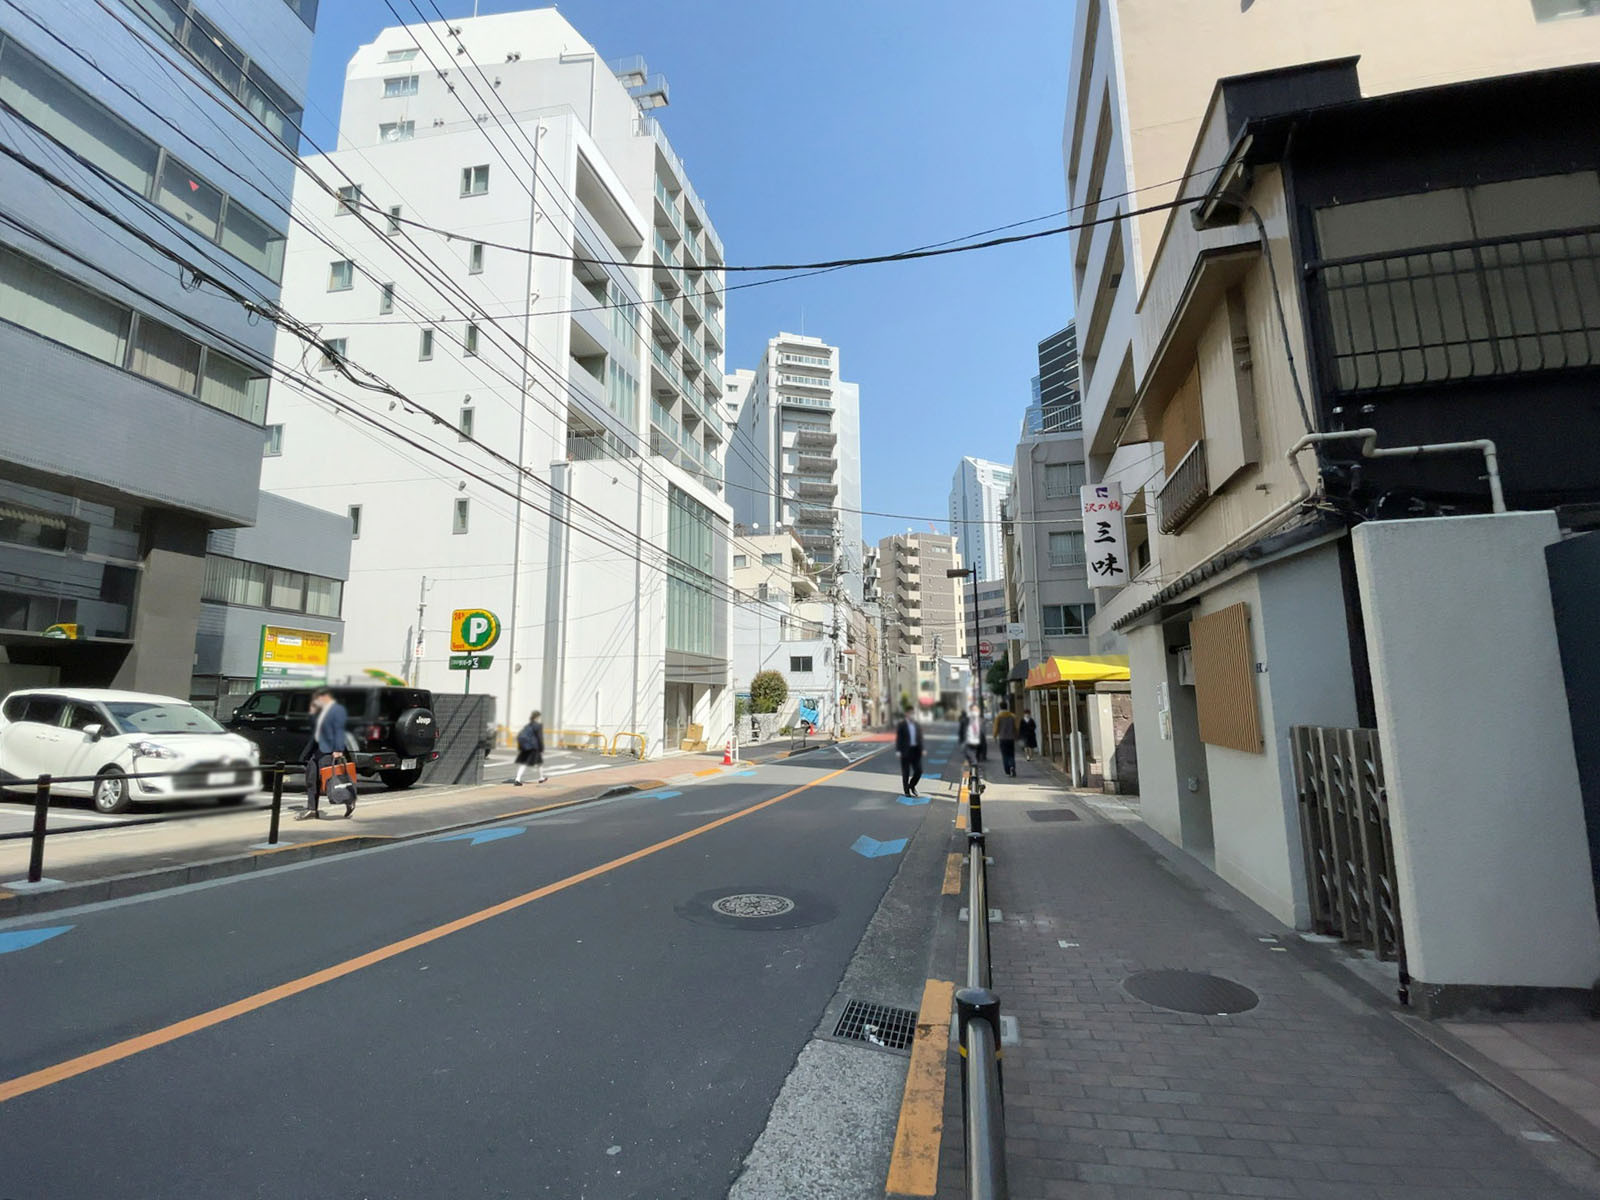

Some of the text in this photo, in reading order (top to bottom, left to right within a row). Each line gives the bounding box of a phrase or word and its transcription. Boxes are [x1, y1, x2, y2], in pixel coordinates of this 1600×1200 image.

[1091, 521, 1124, 576] 三味
[469, 617, 488, 643] P
[416, 716, 432, 725] Jeep
